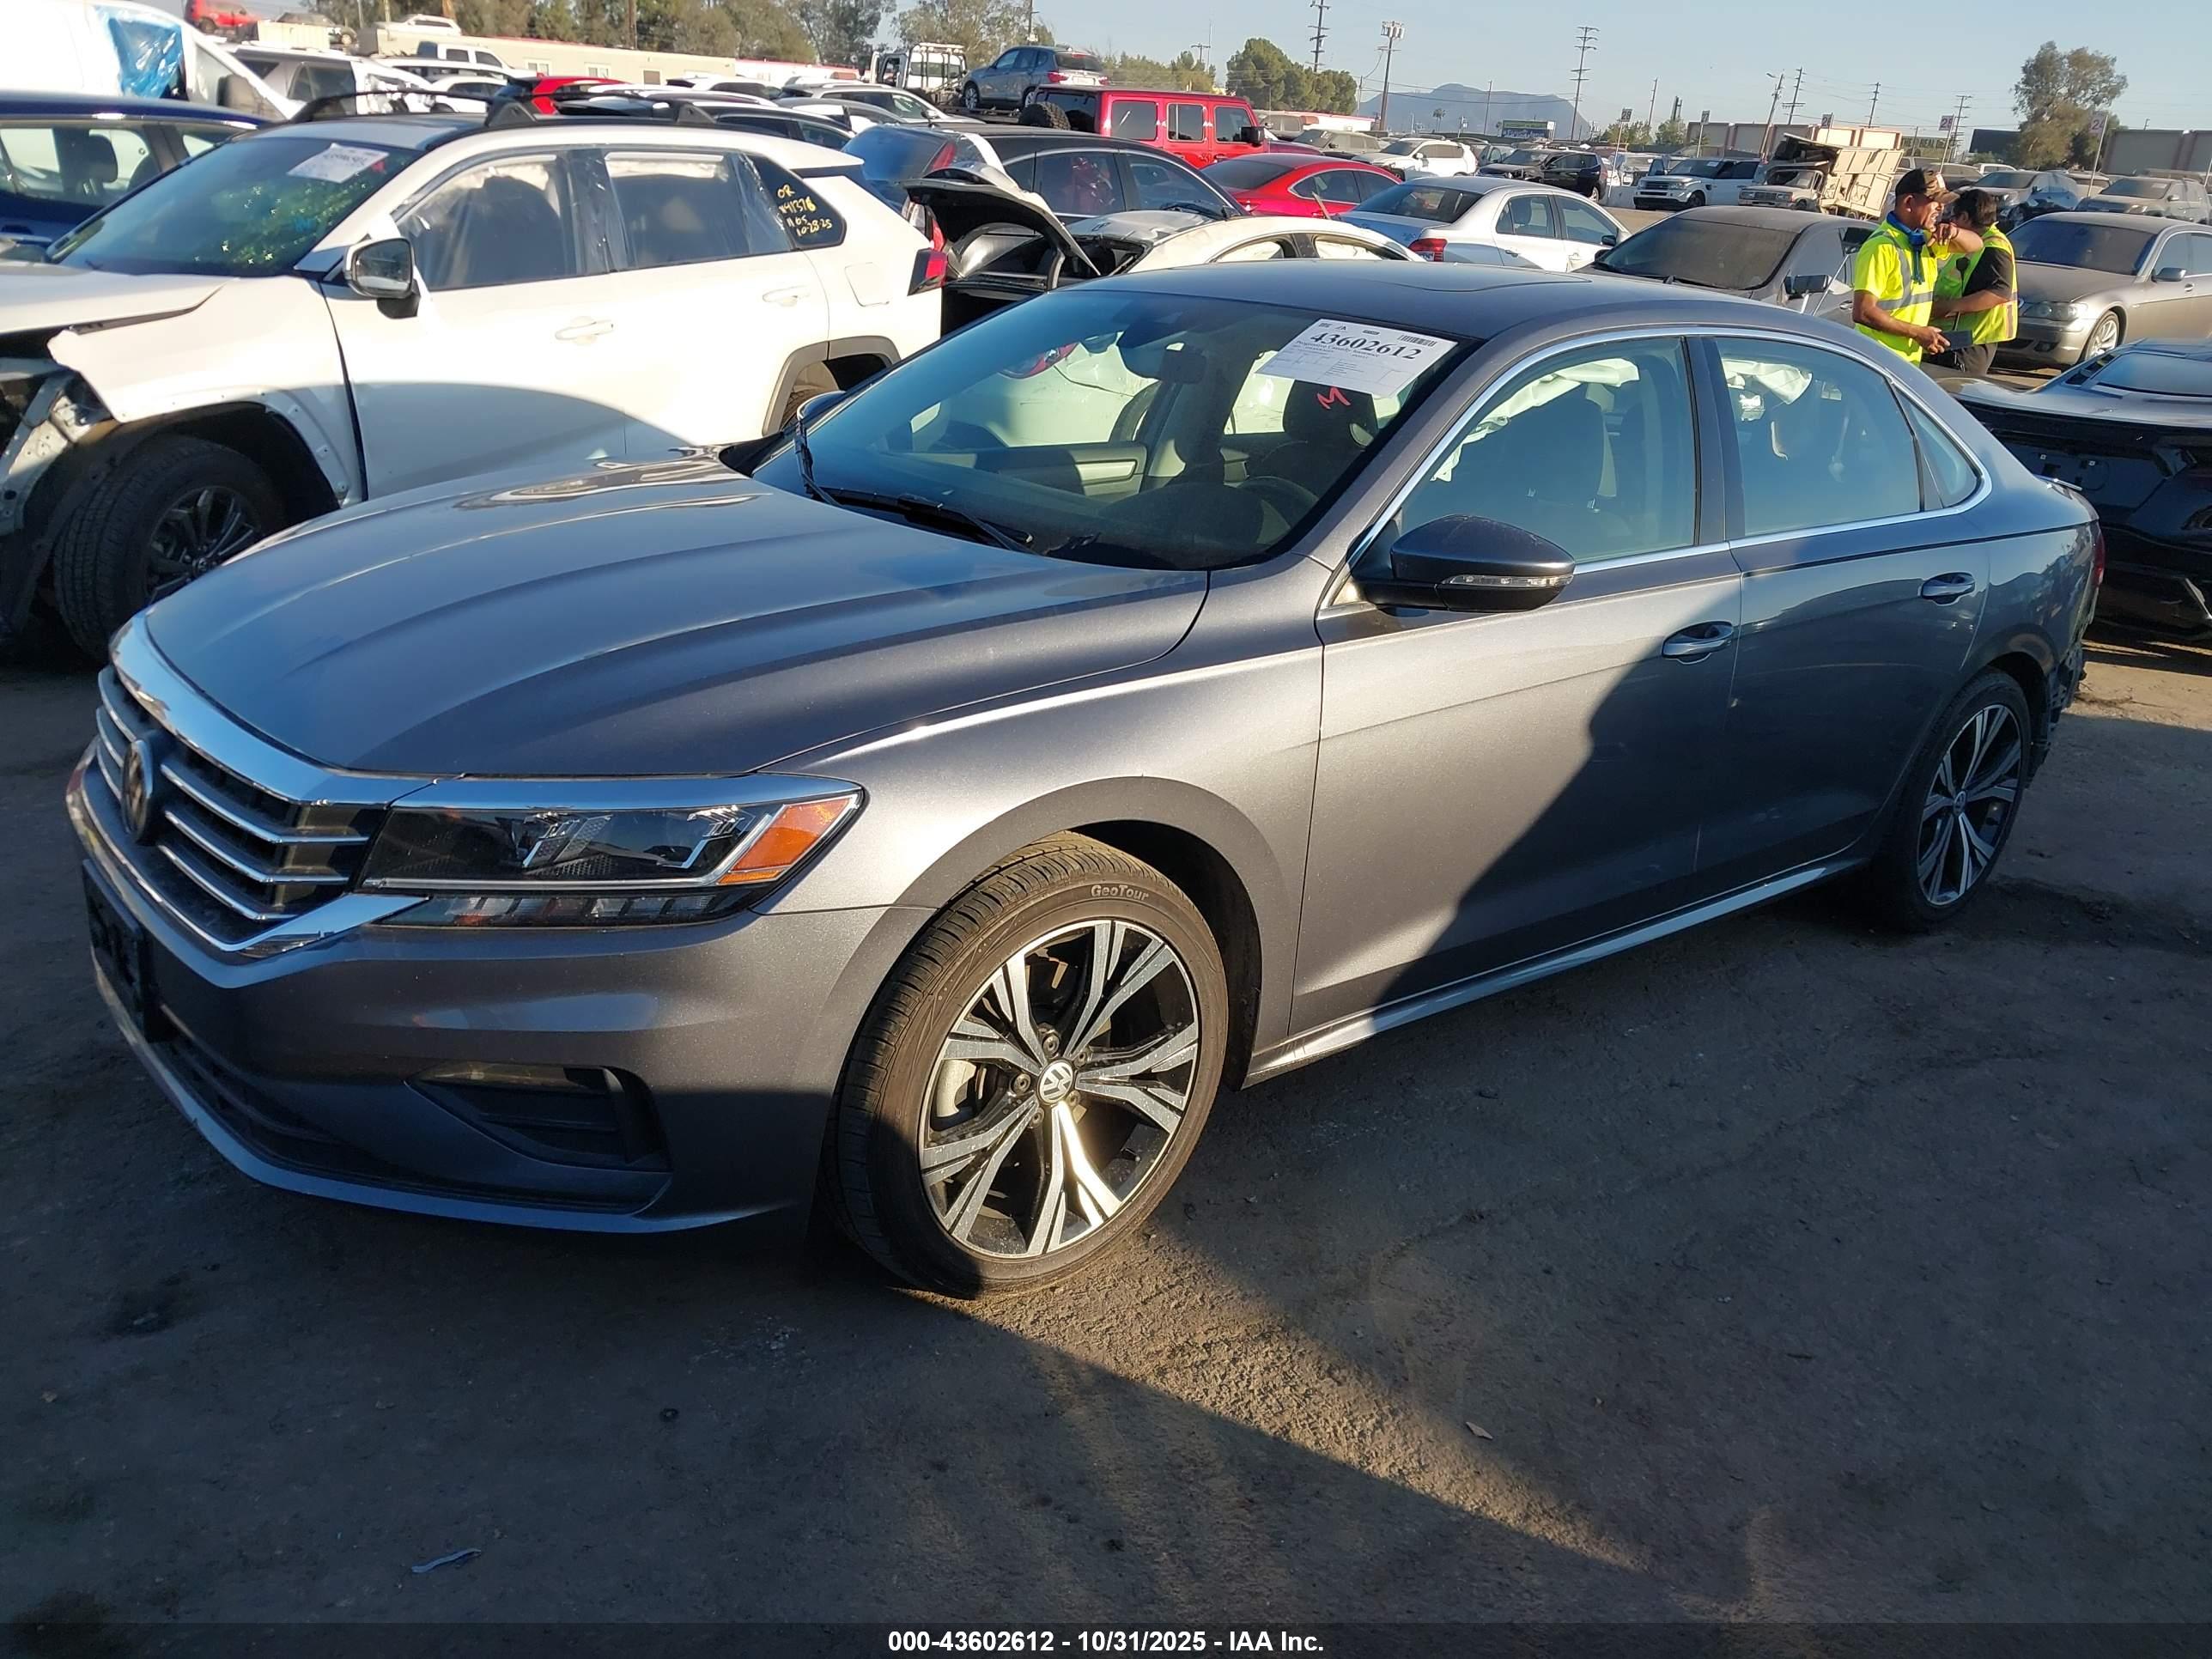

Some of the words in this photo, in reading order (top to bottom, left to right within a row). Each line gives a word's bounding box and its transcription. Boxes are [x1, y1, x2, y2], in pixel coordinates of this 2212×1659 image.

[777, 184, 795, 198] OR
[1310, 331, 1422, 360] 43602612
[1316, 386, 1352, 409] M
[1091, 884, 1149, 901] GeoTour
